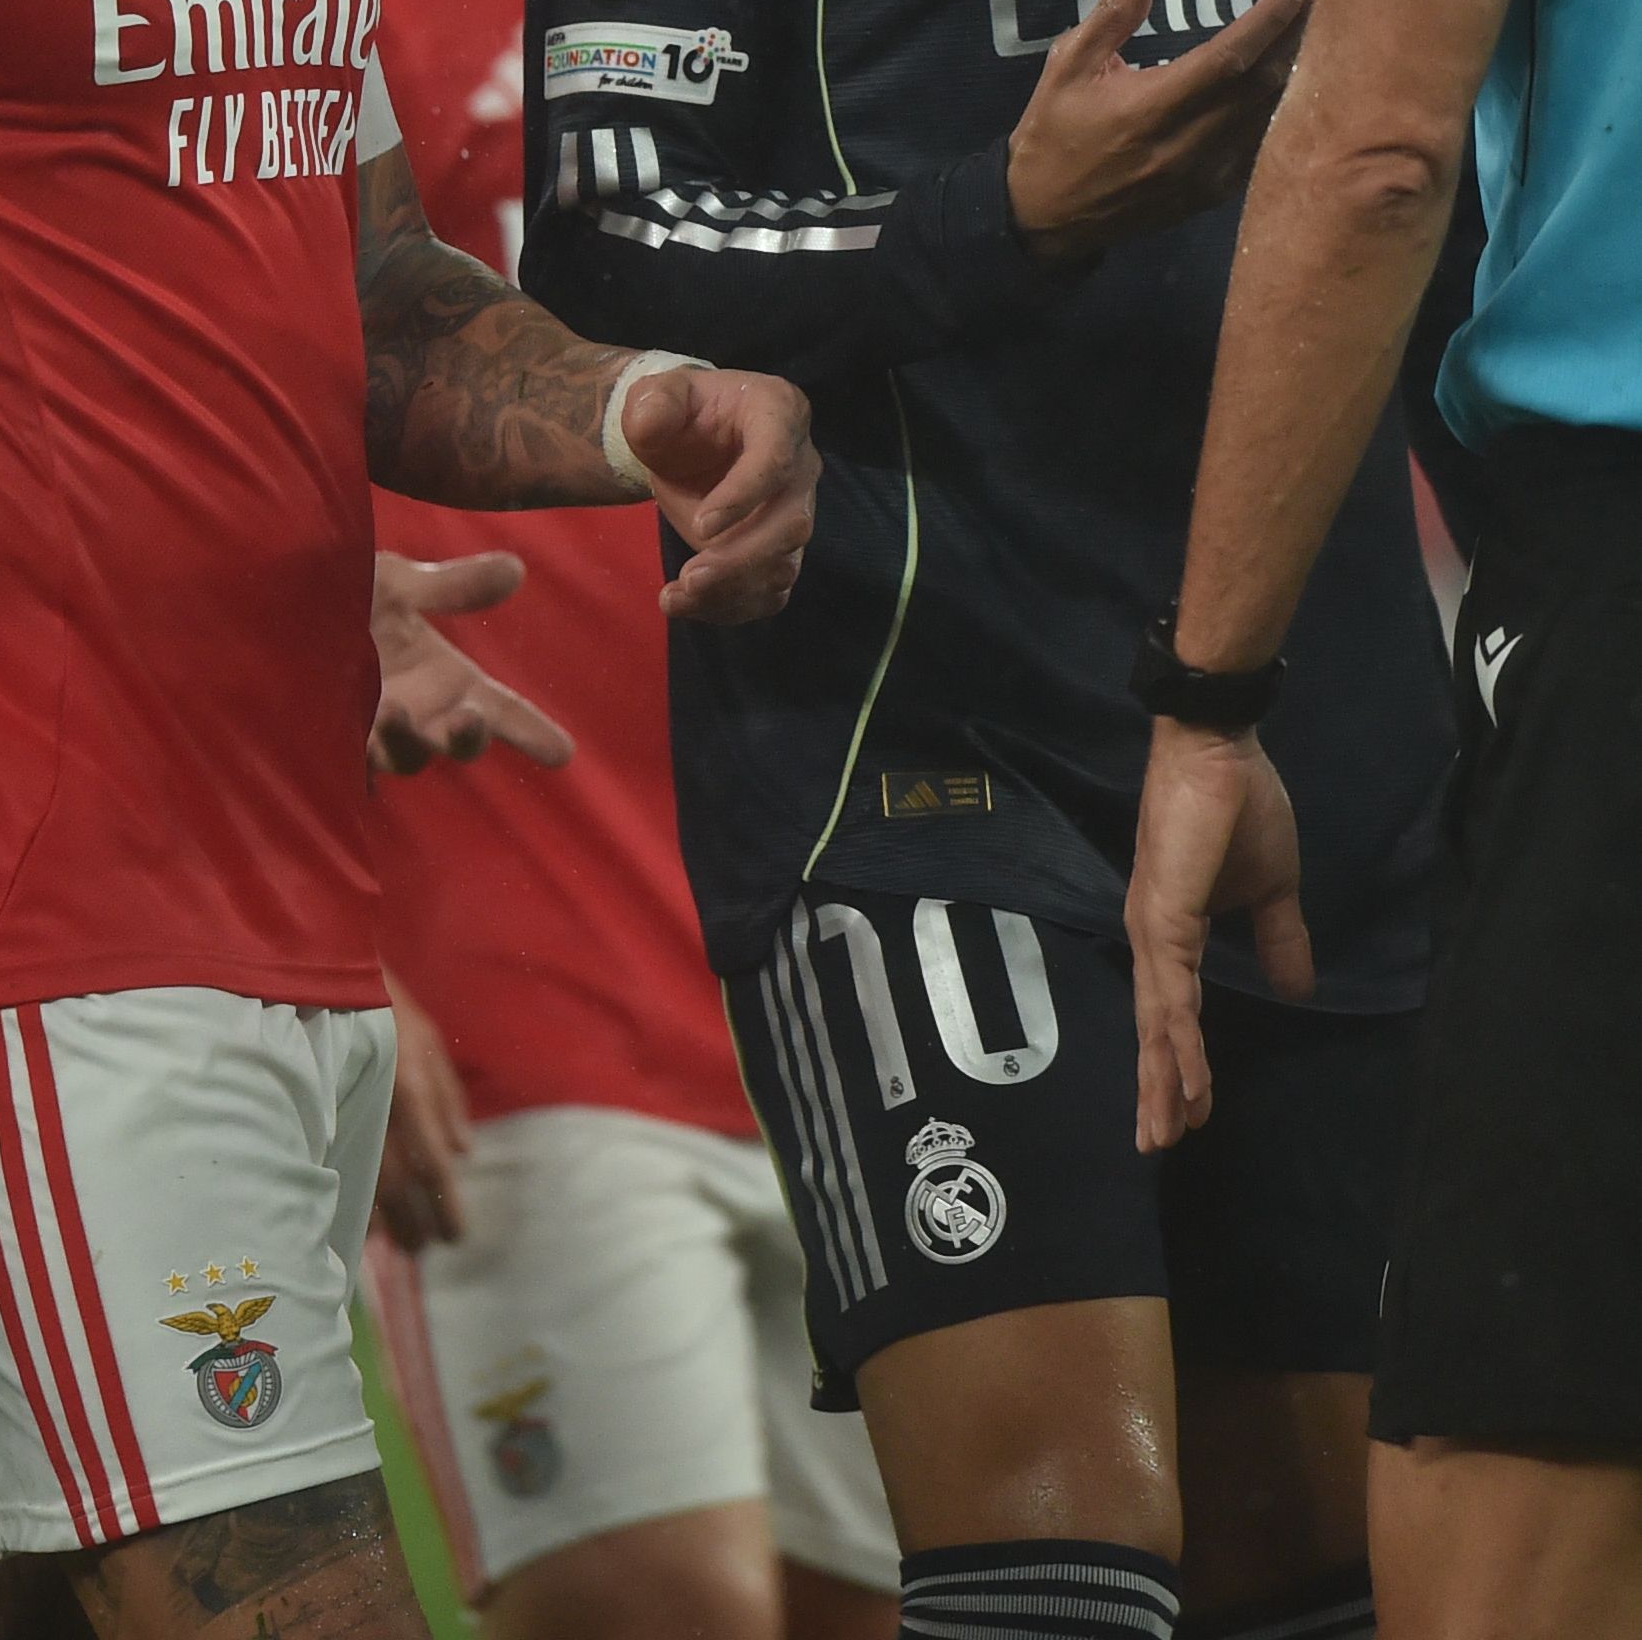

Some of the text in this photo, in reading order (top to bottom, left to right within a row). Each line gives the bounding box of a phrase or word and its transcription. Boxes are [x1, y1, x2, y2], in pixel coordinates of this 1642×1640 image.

[661, 43, 715, 84] 10
[168, 88, 356, 187] FLY BETTER
[814, 897, 1059, 1111] 10
